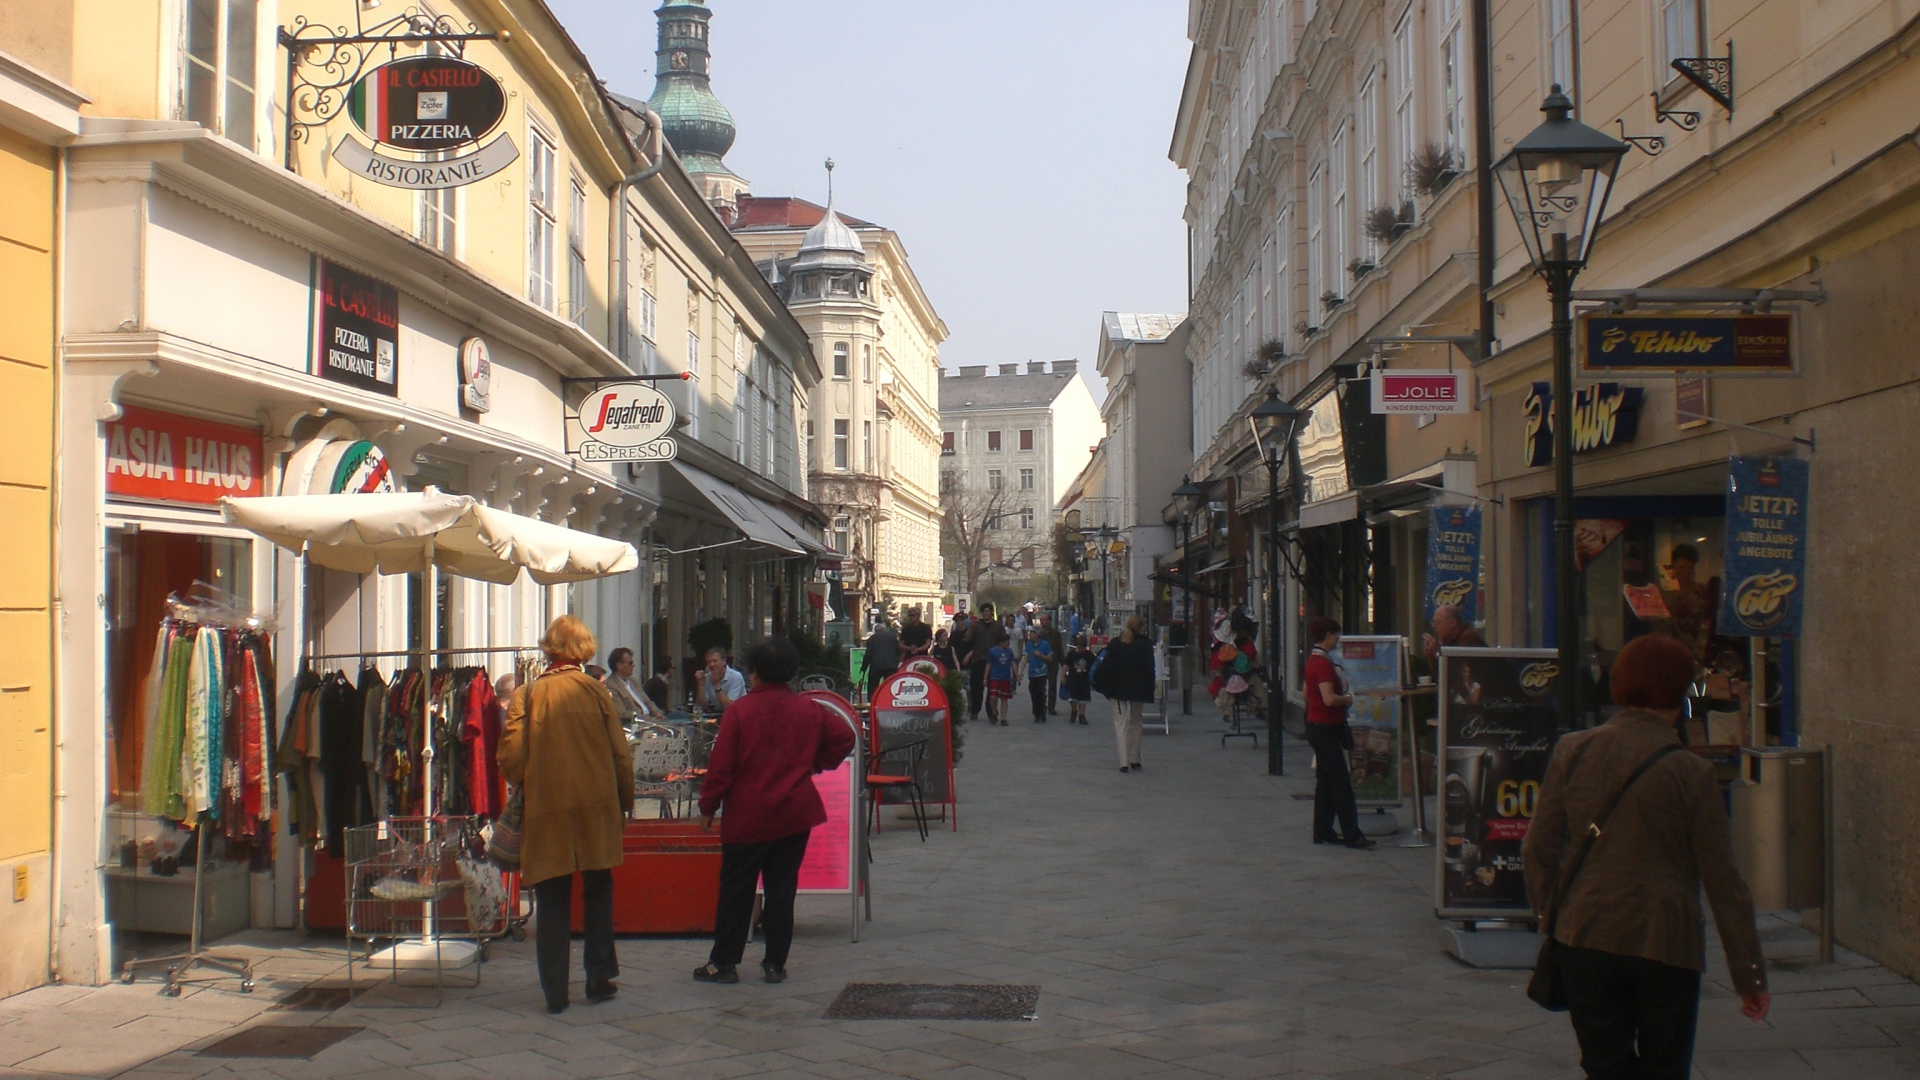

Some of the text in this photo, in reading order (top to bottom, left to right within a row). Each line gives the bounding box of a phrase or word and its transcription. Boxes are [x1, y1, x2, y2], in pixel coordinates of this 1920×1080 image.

[390, 68, 481, 88] IL CASTELLO
[391, 124, 472, 139] PIZZERIA
[366, 157, 484, 185] RISTORANTE
[325, 279, 397, 328] IL CASTELLO
[335, 326, 369, 354] PIZZERIA
[1629, 329, 1723, 353] Tchibo
[329, 348, 374, 378] RISTORANTE
[588, 393, 664, 433] Segafredo
[107, 424, 251, 491] ASIA HAUS
[584, 441, 672, 460] ESPRESSO
[1737, 496, 1798, 516] JETZT:
[1753, 518, 1784, 530] TOLLE
[1437, 531, 1475, 545] JETZT:
[1736, 531, 1799, 546] JUBILÄUMS-
[1739, 547, 1794, 560] ANGEBOTE
